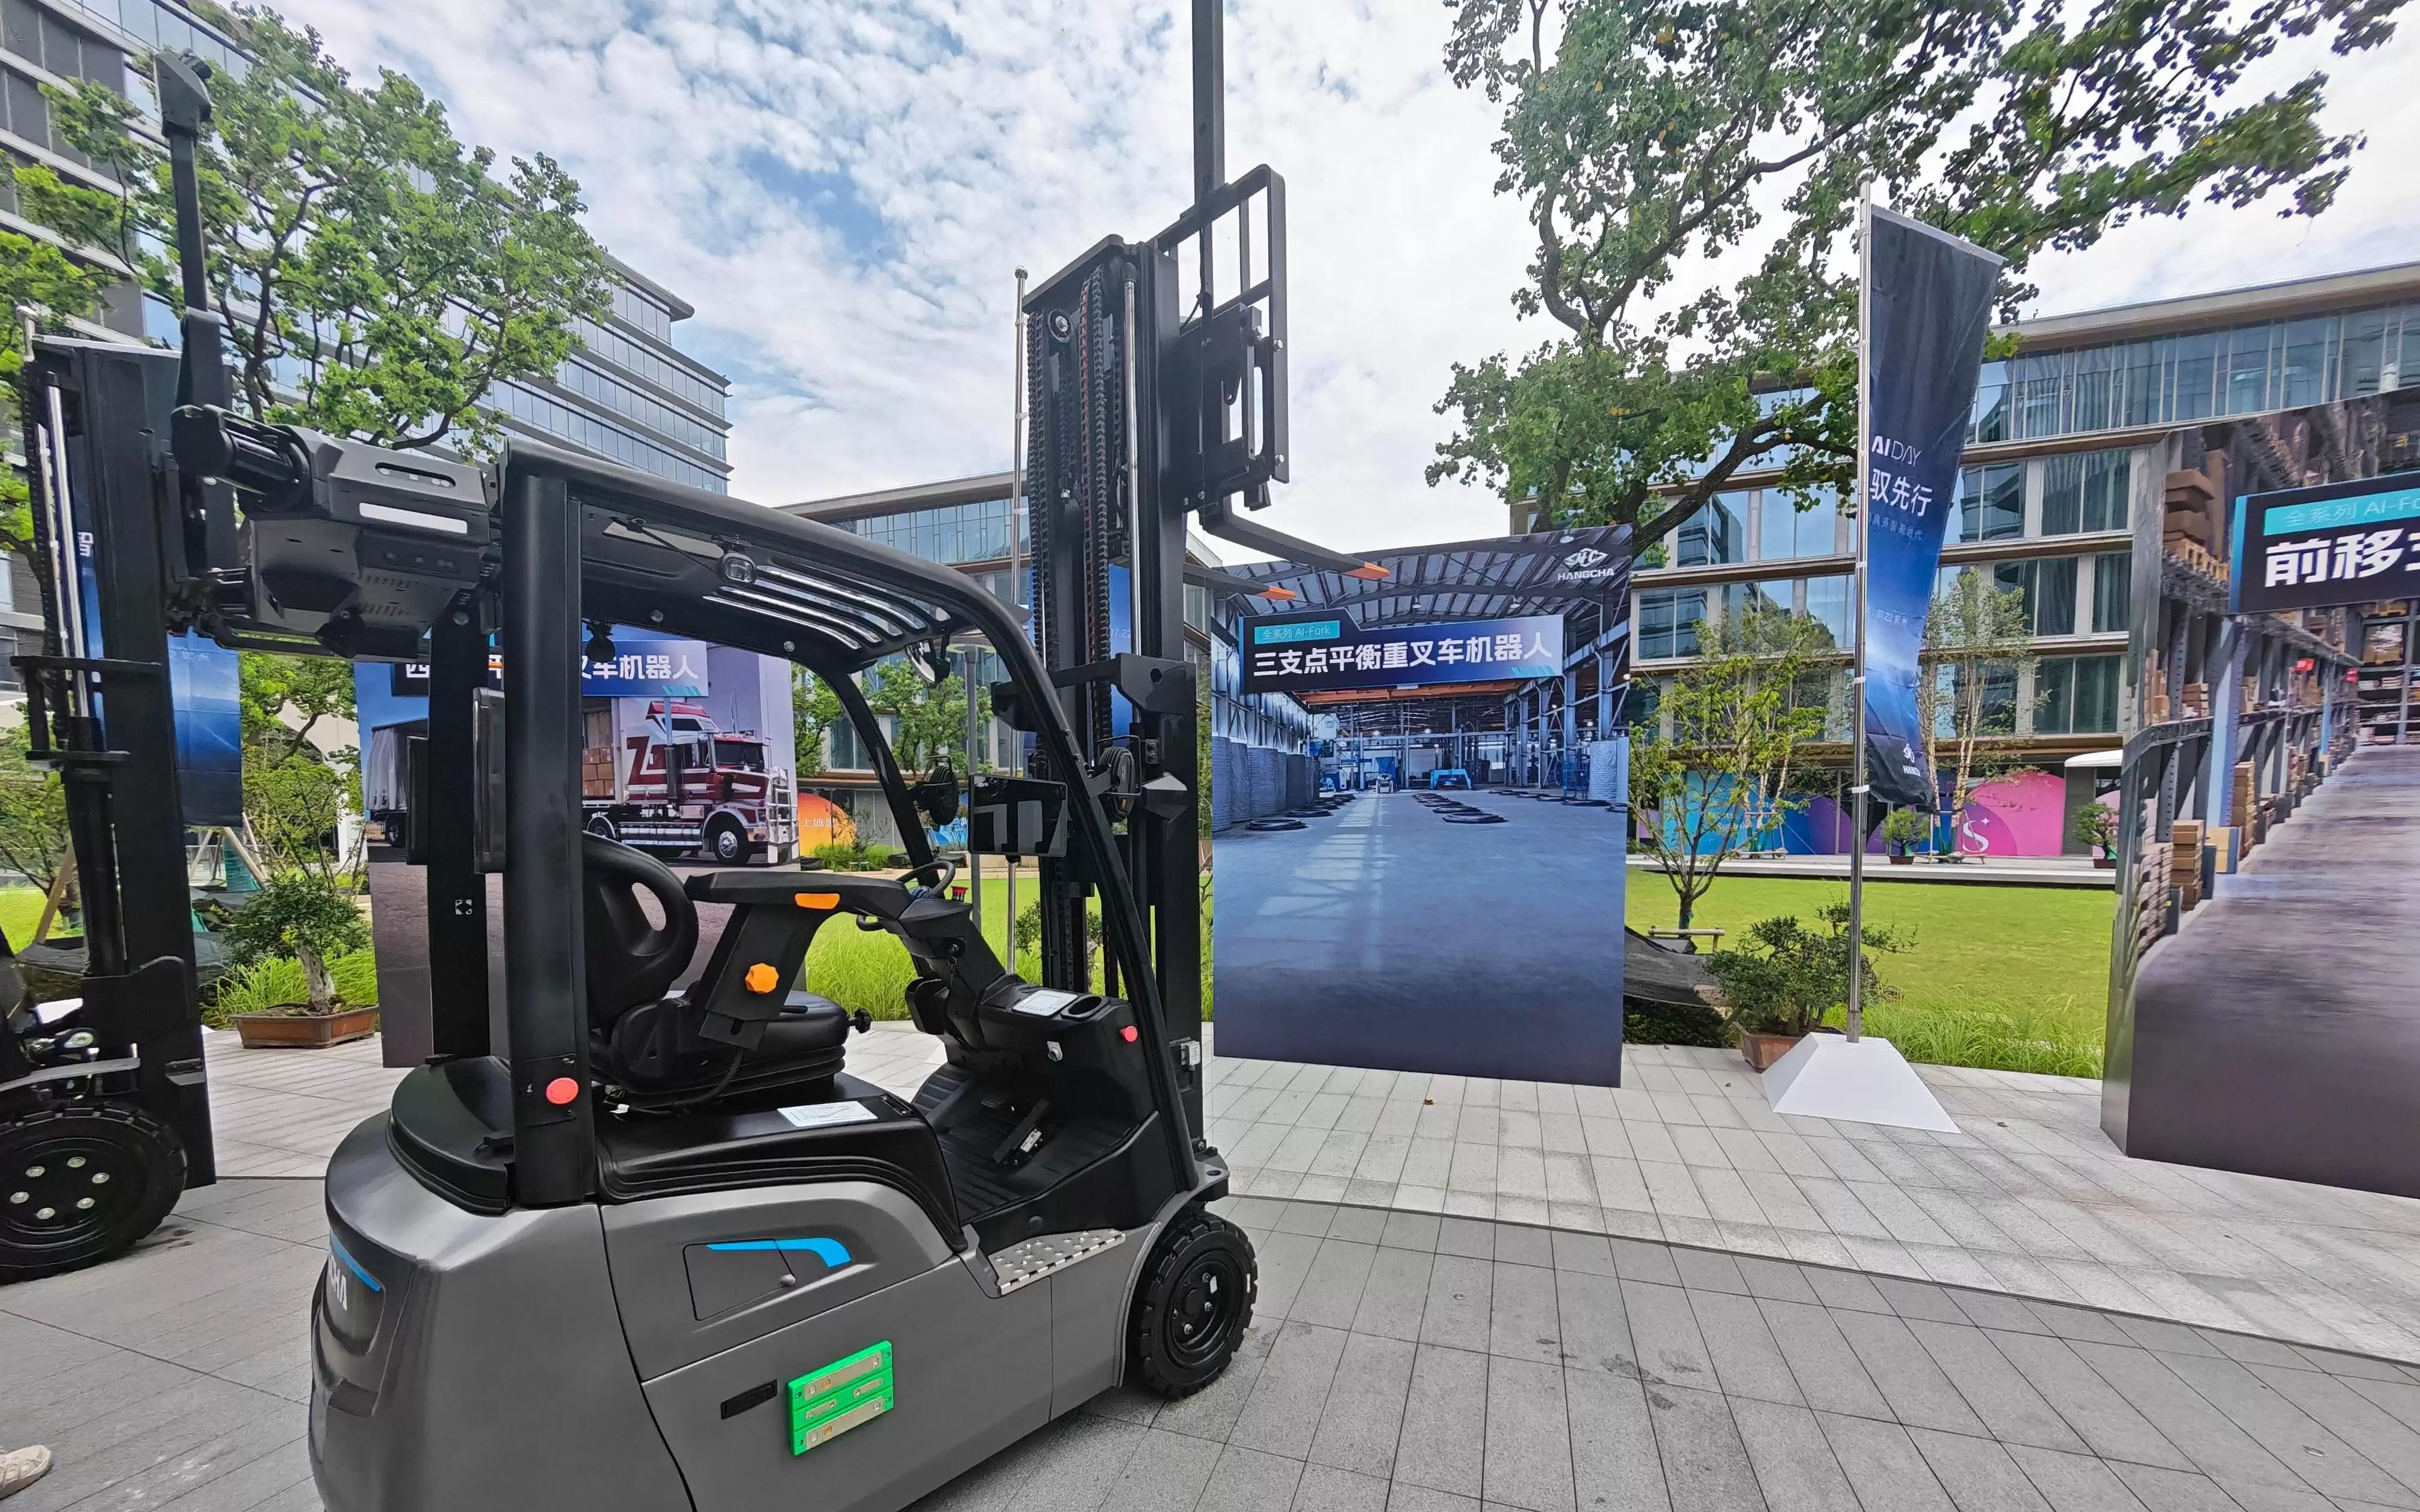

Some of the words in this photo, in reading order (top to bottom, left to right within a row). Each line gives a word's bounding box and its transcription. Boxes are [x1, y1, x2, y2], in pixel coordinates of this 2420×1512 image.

[2283, 502, 2358, 527] 全系列
[1558, 568, 1615, 581] HANGCHA
[1262, 627, 1293, 640] 全系列
[1295, 625, 1331, 638] AI-Fork
[1253, 632, 1553, 677] 三支点平衡重叉车机器人
